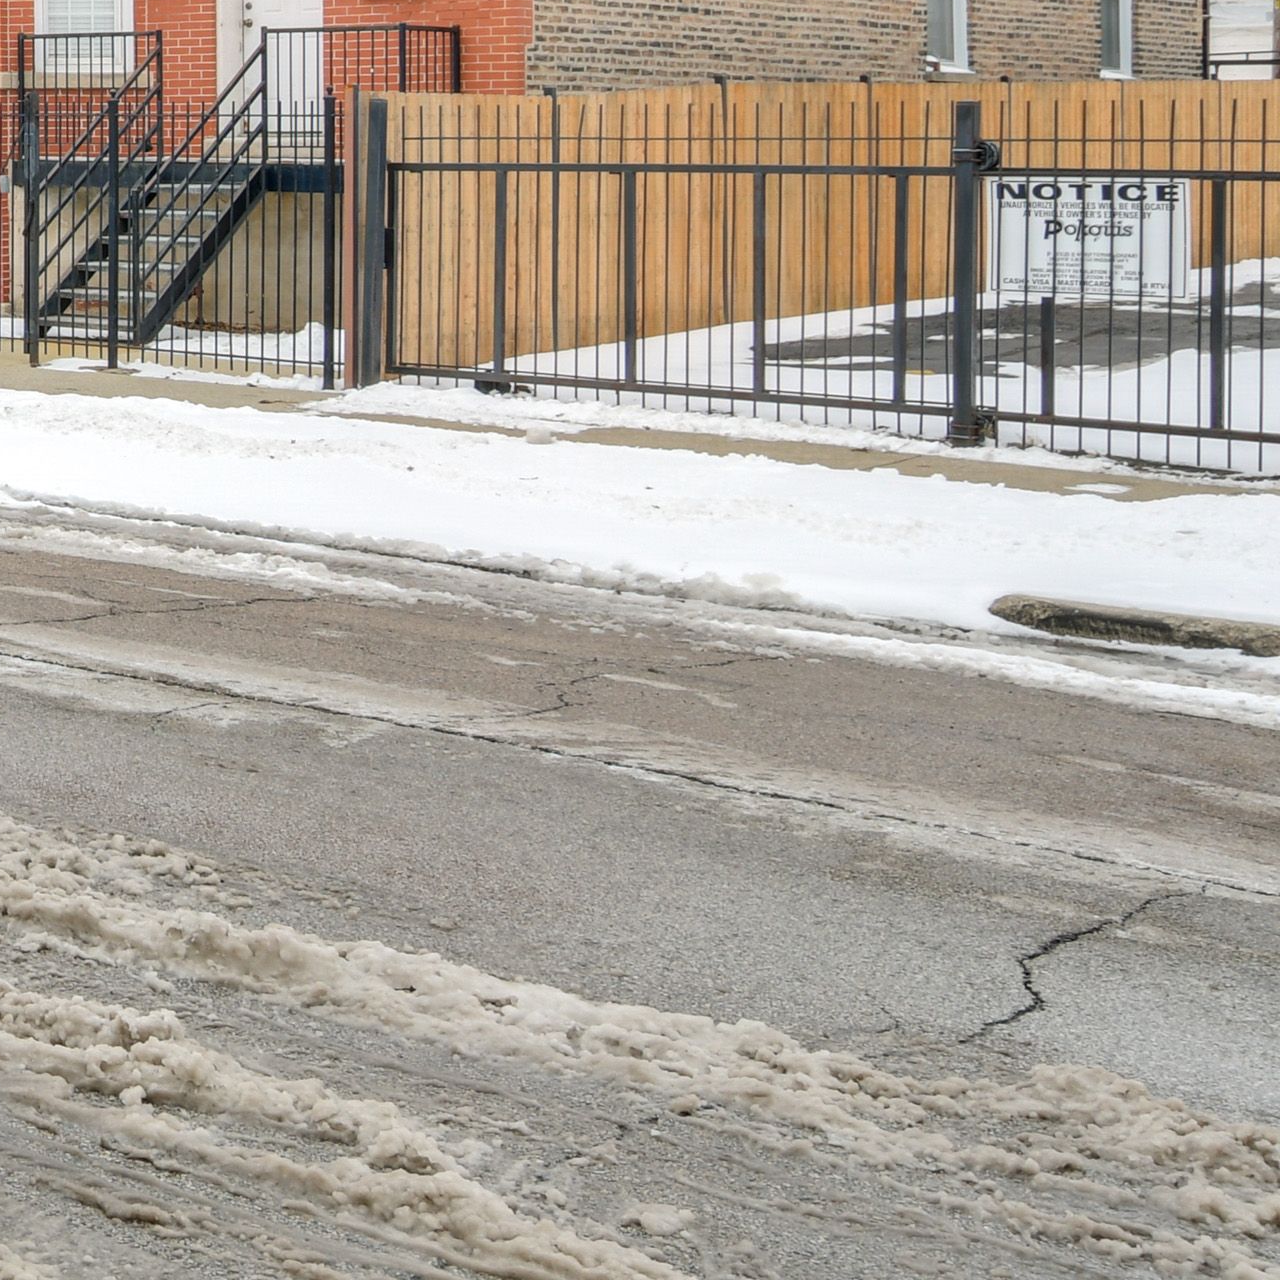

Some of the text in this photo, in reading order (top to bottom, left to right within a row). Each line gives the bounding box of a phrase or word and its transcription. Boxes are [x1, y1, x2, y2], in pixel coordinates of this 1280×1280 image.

[997, 183, 1179, 202] NOTICE
[1000, 201, 1058, 209] UNAUTORIZE
[1061, 201, 1096, 210] VEHICES
[1104, 211, 1139, 219] EPENSE
[1057, 279, 1112, 287] MASTCARD
